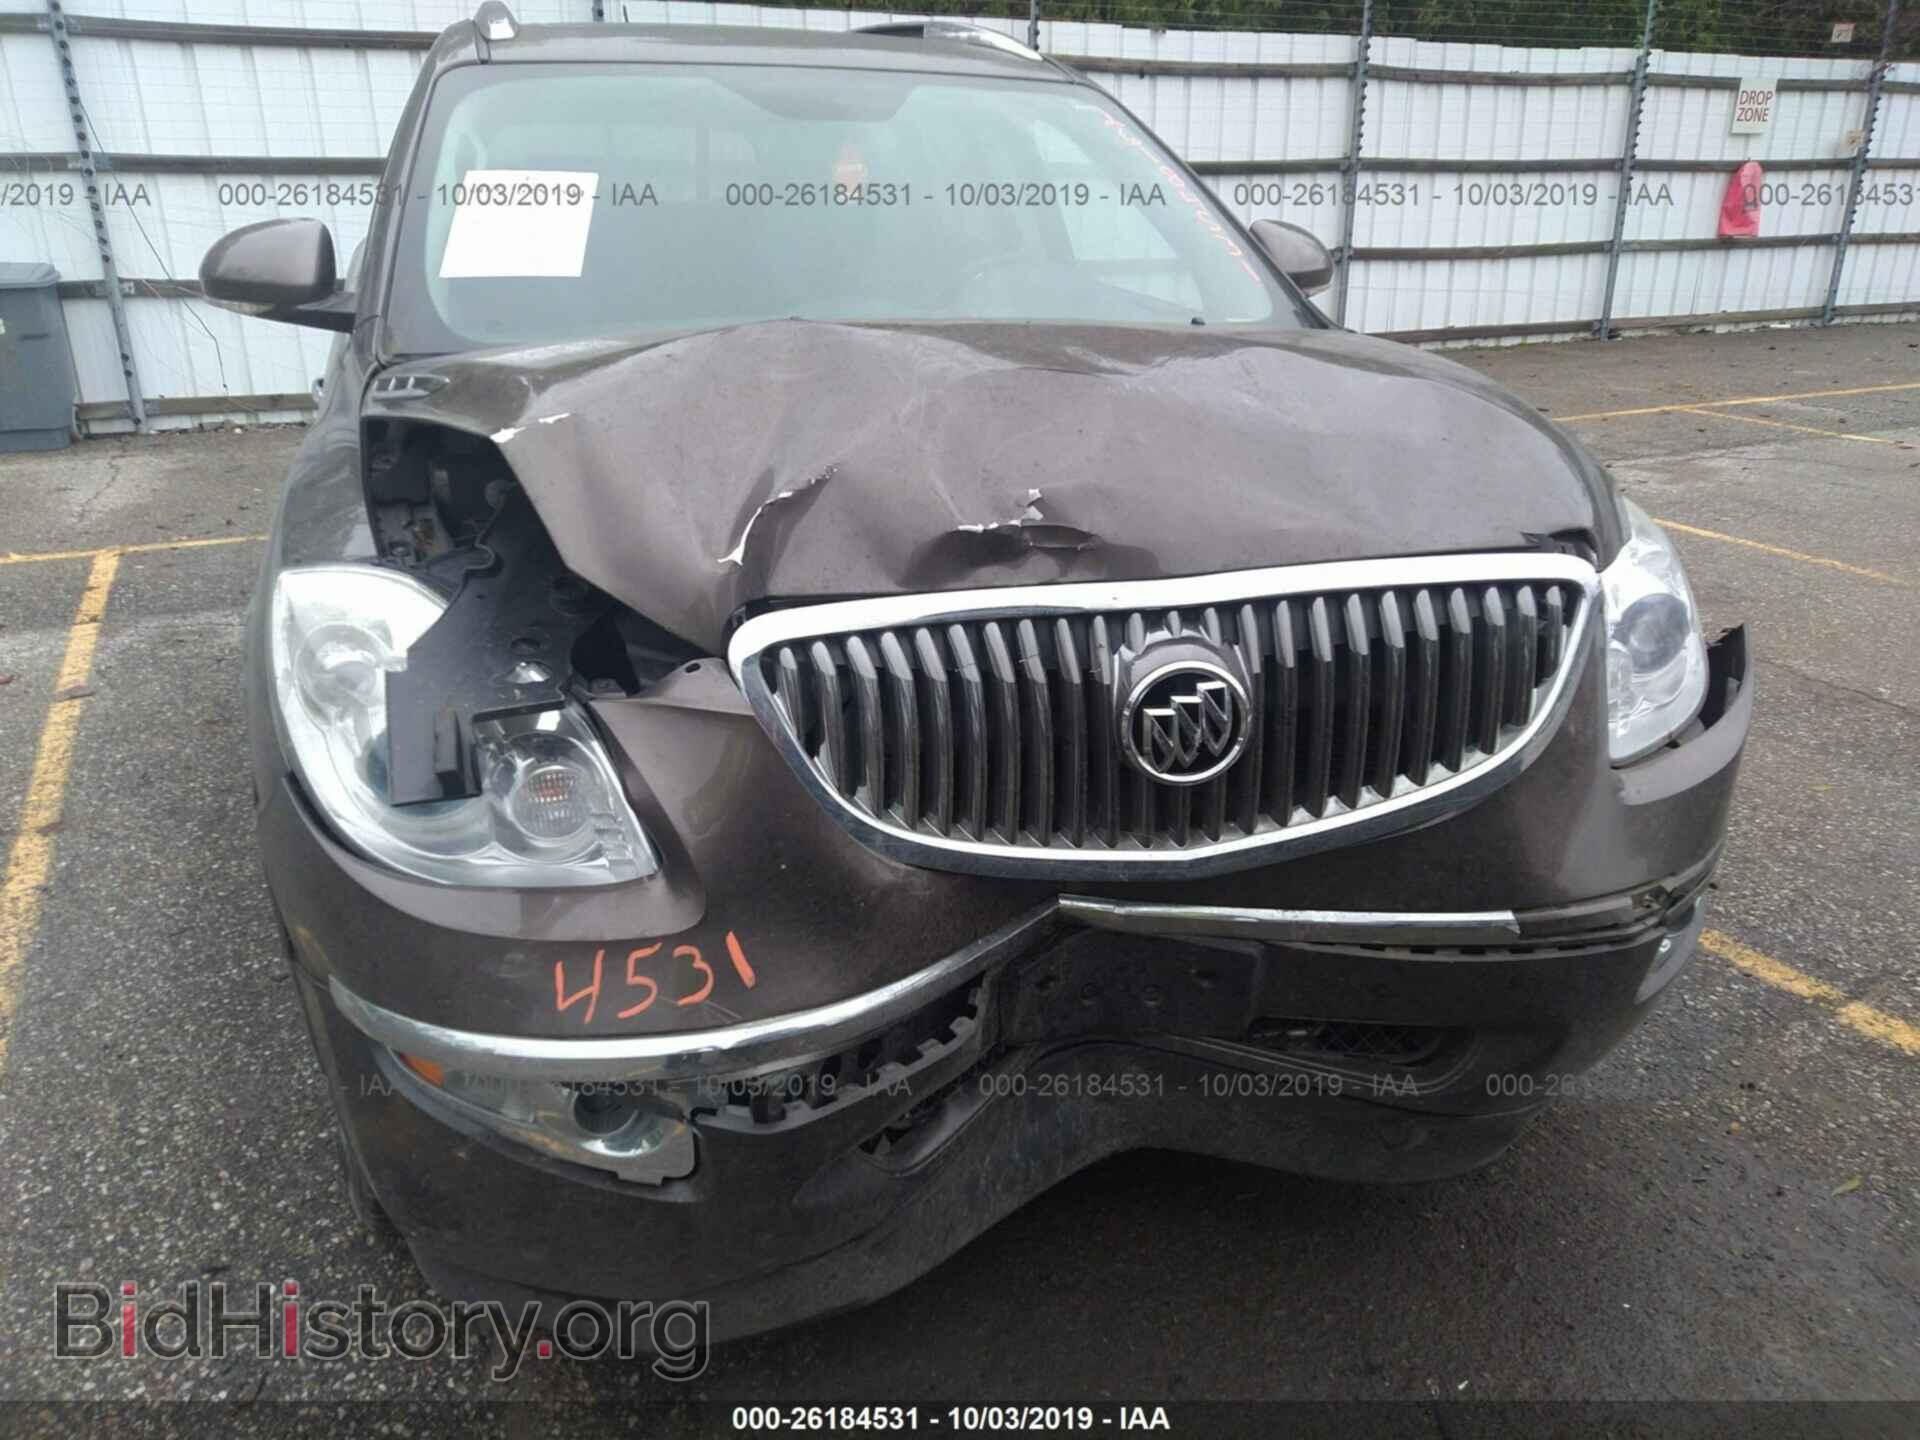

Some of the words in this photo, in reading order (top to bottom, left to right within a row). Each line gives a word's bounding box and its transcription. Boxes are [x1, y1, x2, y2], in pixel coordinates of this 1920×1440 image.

[1739, 90, 1773, 105] DROP
[1737, 108, 1769, 122] ZONE
[554, 929, 757, 1025] 4531
